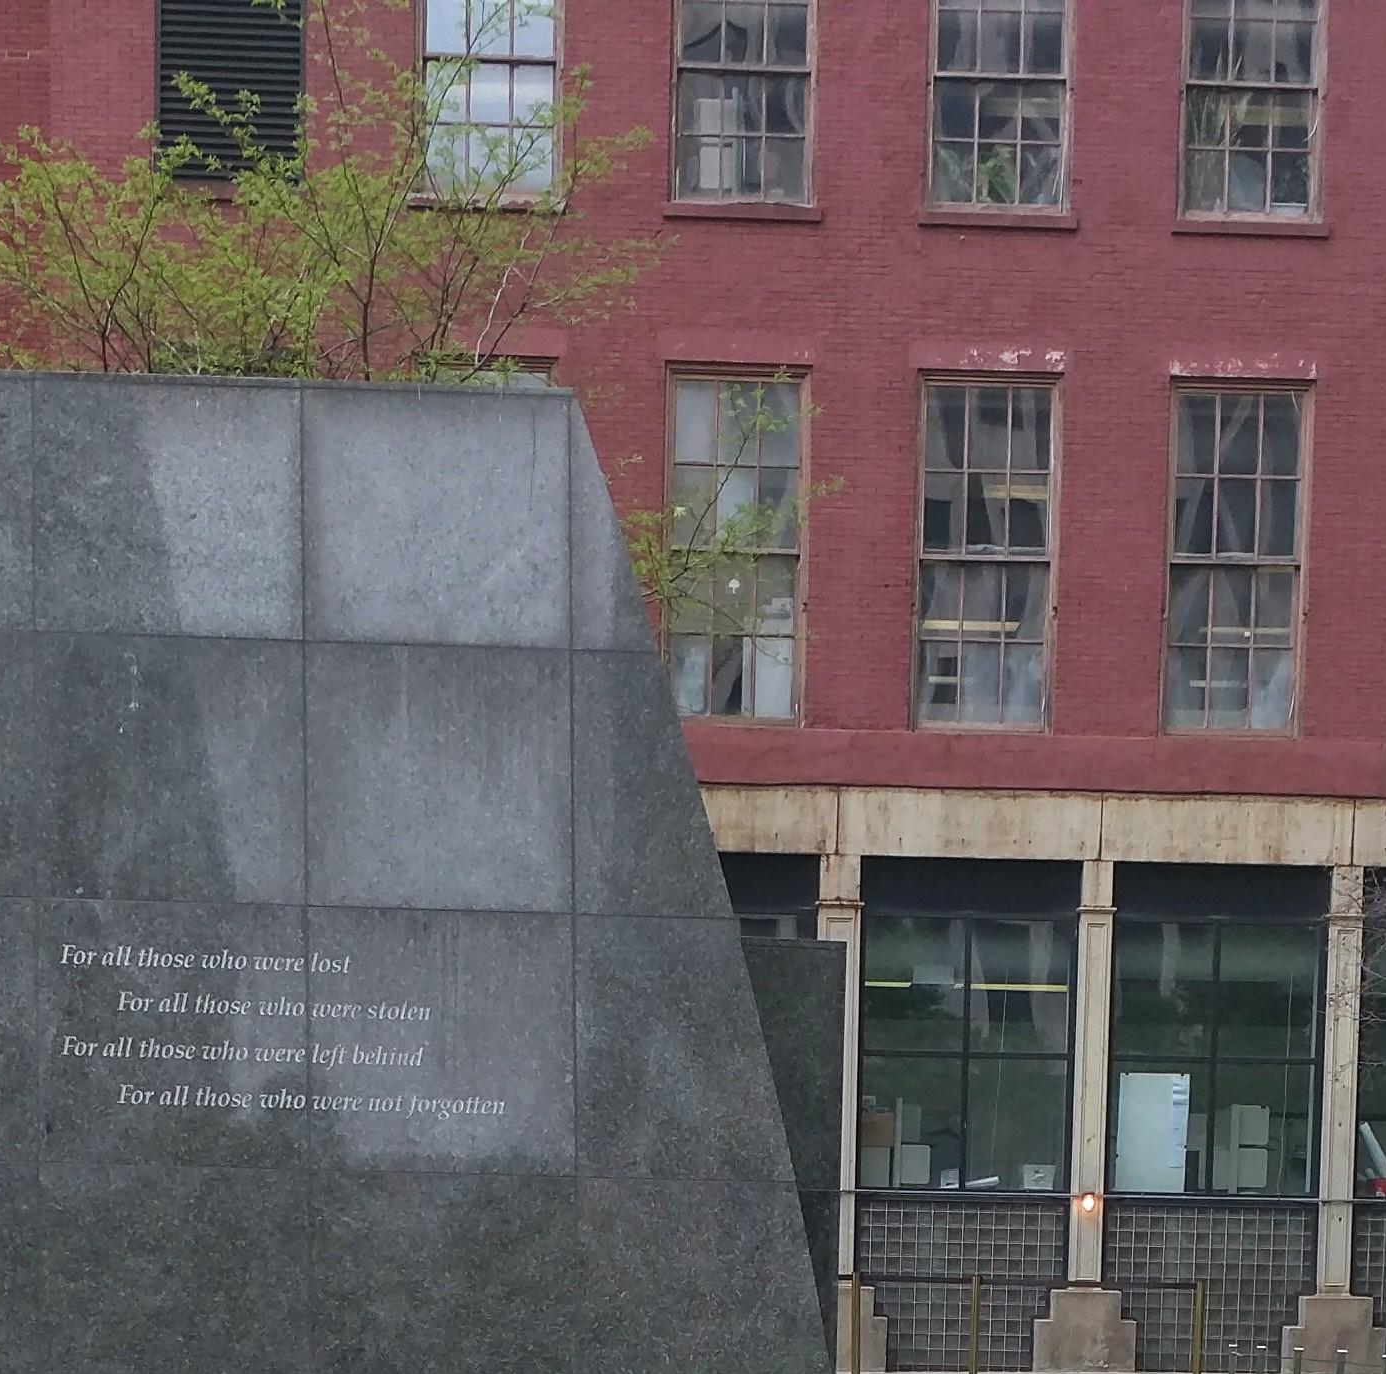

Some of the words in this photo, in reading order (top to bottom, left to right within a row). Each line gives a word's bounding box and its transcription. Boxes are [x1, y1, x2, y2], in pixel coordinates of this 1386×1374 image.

[60, 944, 97, 966] For
[101, 946, 131, 967] all
[137, 947, 195, 969] those
[201, 949, 247, 971] who
[254, 954, 305, 972] were
[311, 952, 351, 974] lost
[116, 990, 154, 1012] For
[159, 992, 189, 1014] all
[195, 993, 252, 1016] those
[259, 996, 305, 1017] who
[311, 1001, 362, 1019] were
[367, 1000, 431, 1021] stolen
[62, 1035, 99, 1057] For
[103, 1037, 133, 1058] all
[139, 1037, 197, 1060] those
[201, 1040, 248, 1062] who
[255, 1046, 306, 1064] were
[311, 1043, 347, 1071] left
[352, 1044, 424, 1067] behind
[116, 1083, 155, 1105] For
[159, 1085, 189, 1107] all
[195, 1086, 253, 1108] those
[259, 1088, 306, 1110] who
[312, 1094, 363, 1112] were
[367, 1094, 404, 1112] not
[406, 1096, 506, 1121] forgotten
